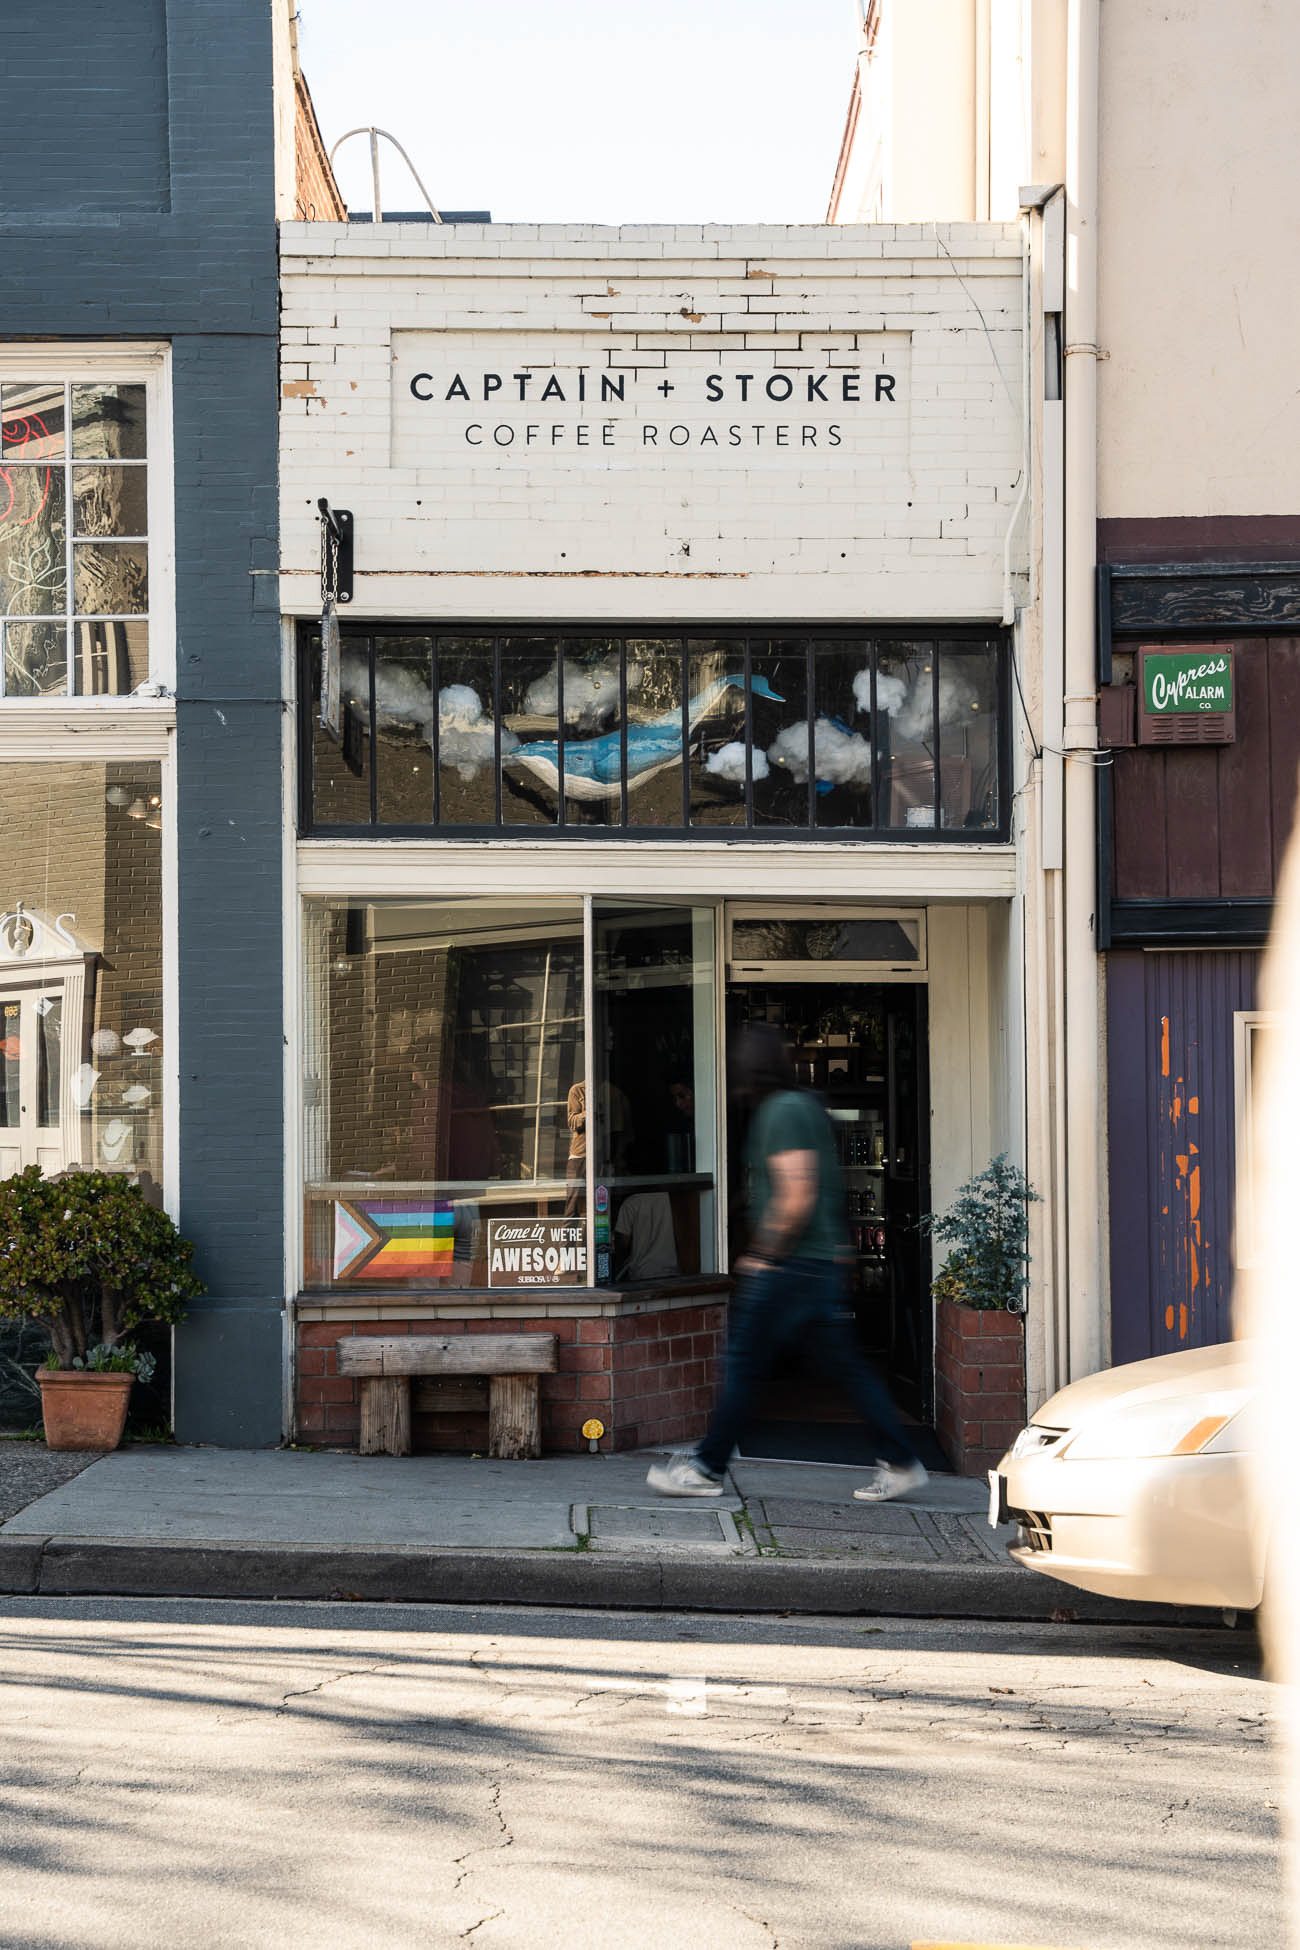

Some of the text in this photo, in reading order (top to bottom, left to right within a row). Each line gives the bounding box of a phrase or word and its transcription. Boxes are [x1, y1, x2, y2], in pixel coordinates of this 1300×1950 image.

[409, 373, 626, 402] CAPTAIN
[705, 374, 897, 402] STOKER
[464, 424, 843, 447] COFFEE ROASTERS
[1152, 658, 1227, 709] Cypress
[1184, 686, 1225, 699] ALARM
[494, 1224, 530, 1242] Come
[531, 1223, 546, 1243] in
[550, 1227, 583, 1242] WE'RE
[491, 1247, 587, 1272] AWESOME
